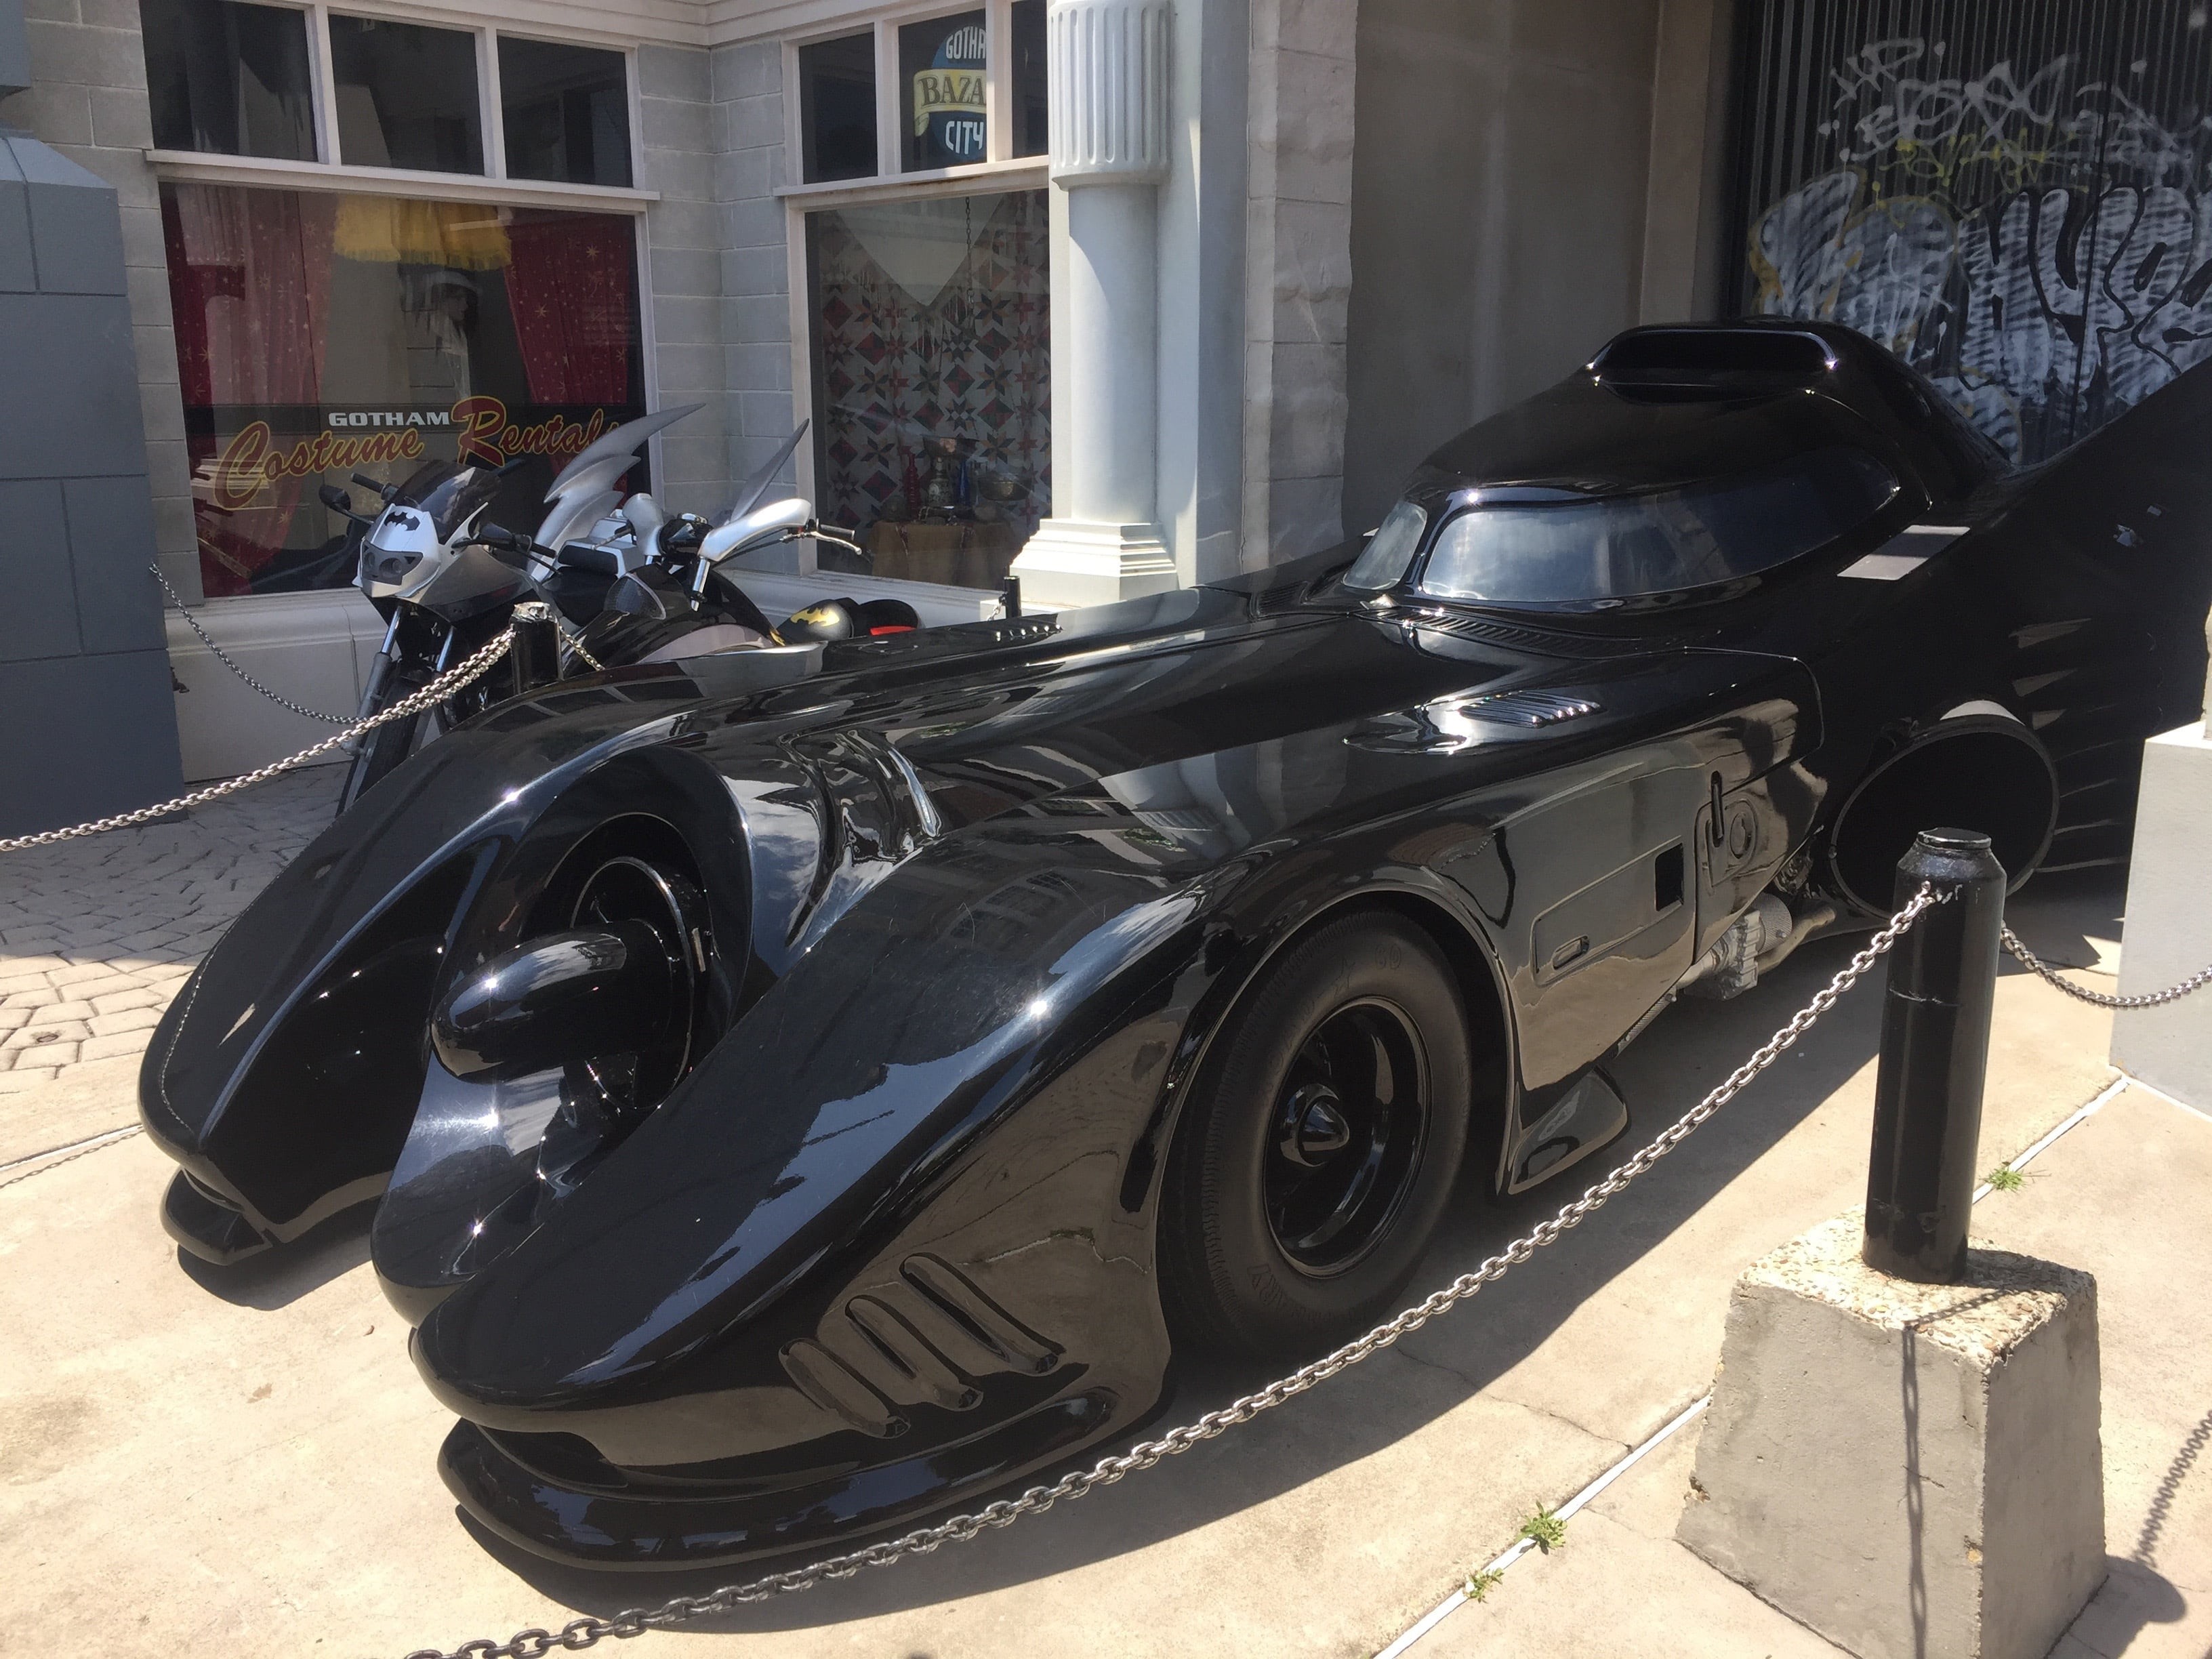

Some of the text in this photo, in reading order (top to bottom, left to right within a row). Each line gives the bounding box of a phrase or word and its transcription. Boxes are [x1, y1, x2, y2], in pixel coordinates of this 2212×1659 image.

[945, 121, 984, 155] CITY
[329, 411, 450, 426] GOTHAM
[213, 396, 619, 508] Costume Rental
